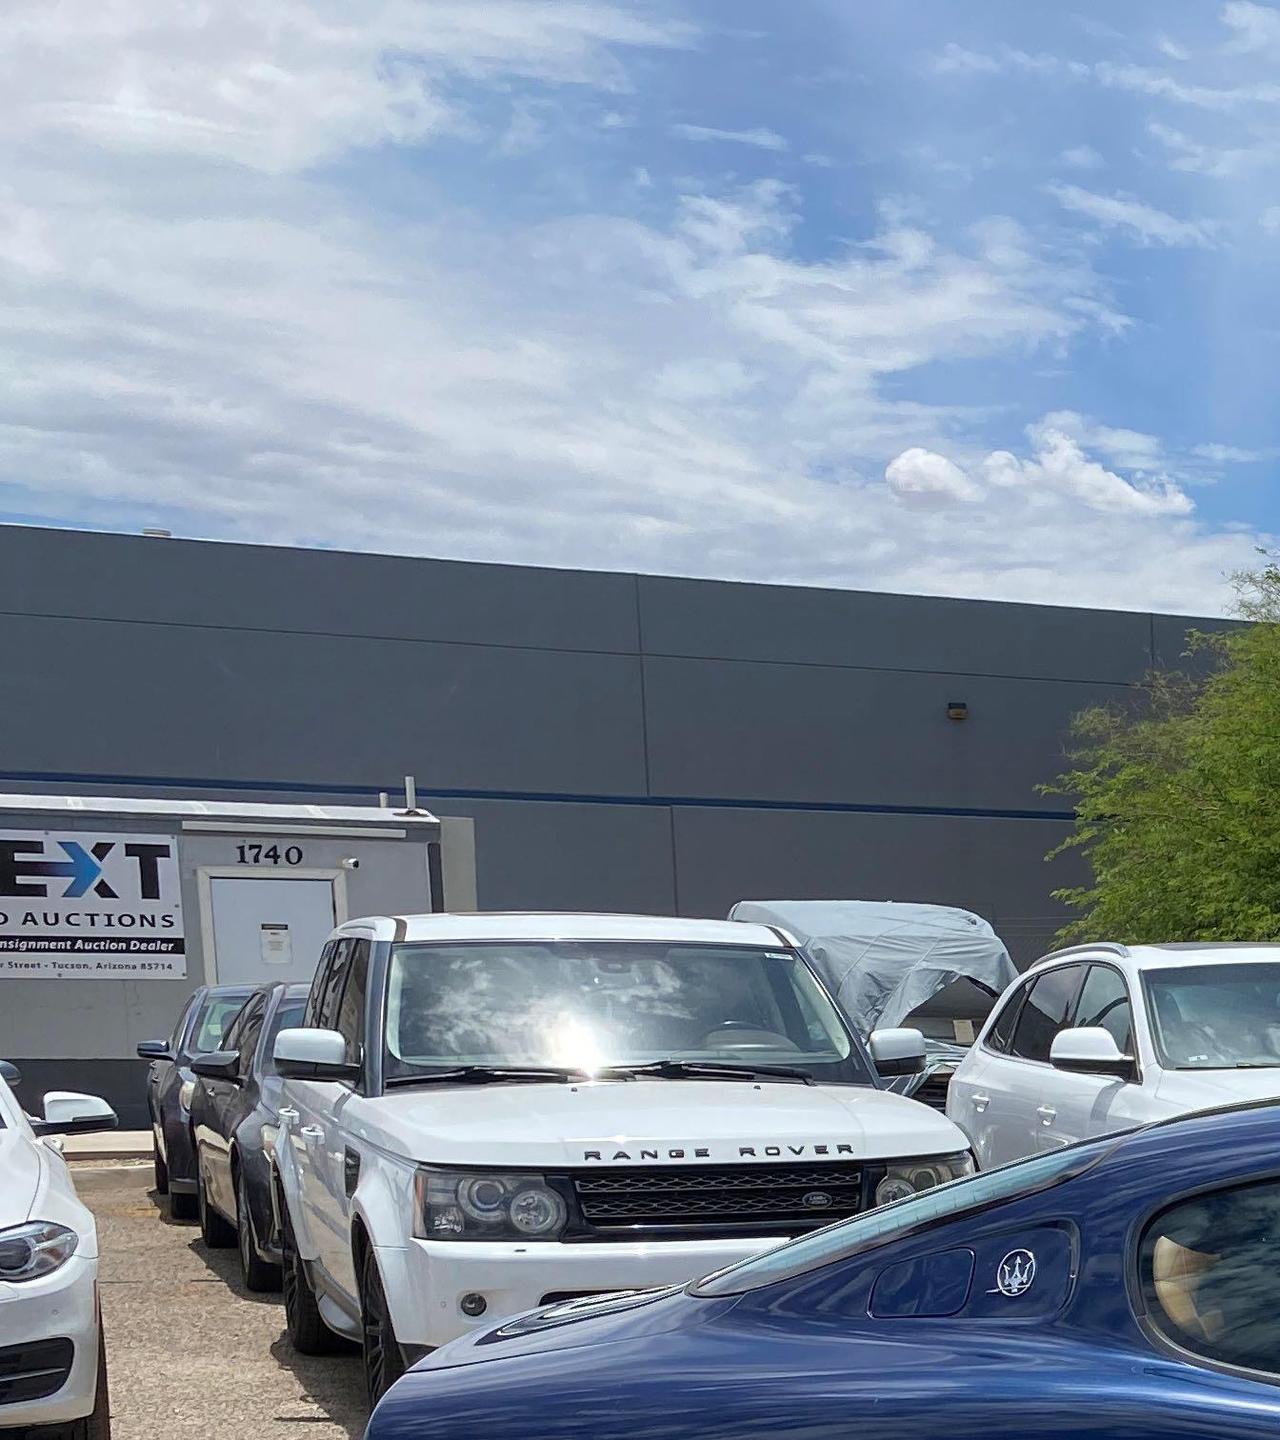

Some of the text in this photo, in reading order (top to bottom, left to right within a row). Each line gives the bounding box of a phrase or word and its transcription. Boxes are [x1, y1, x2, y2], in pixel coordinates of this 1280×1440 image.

[236, 844, 303, 865] 1740
[21, 912, 175, 928] AUCTIONS
[74, 940, 126, 950] Auction
[130, 941, 174, 951] Dealer
[7, 961, 41, 969] Street
[51, 962, 92, 970] Tucson,
[96, 962, 137, 970] Arizona
[584, 1144, 854, 1161] RANGE ROVER
